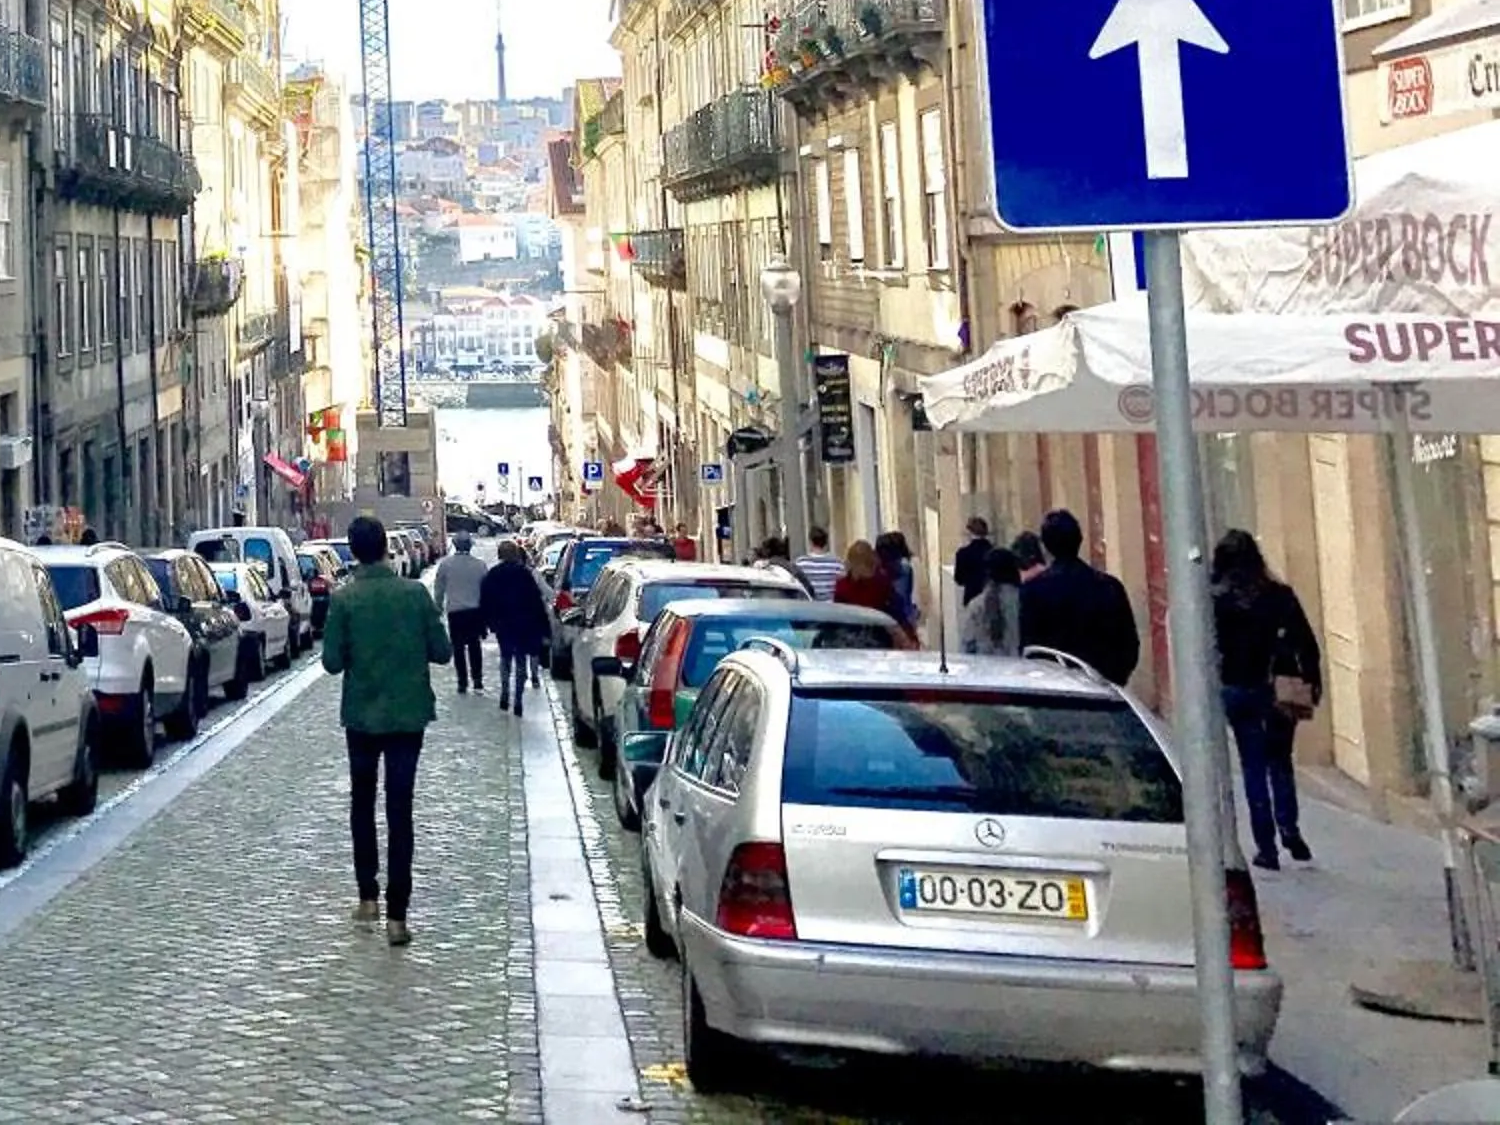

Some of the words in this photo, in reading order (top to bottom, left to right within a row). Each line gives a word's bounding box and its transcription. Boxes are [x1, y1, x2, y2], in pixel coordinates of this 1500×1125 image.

[1401, 213, 1492, 287] BOCK
[1344, 321, 1500, 364] SUPER
[588, 464, 599, 478] P
